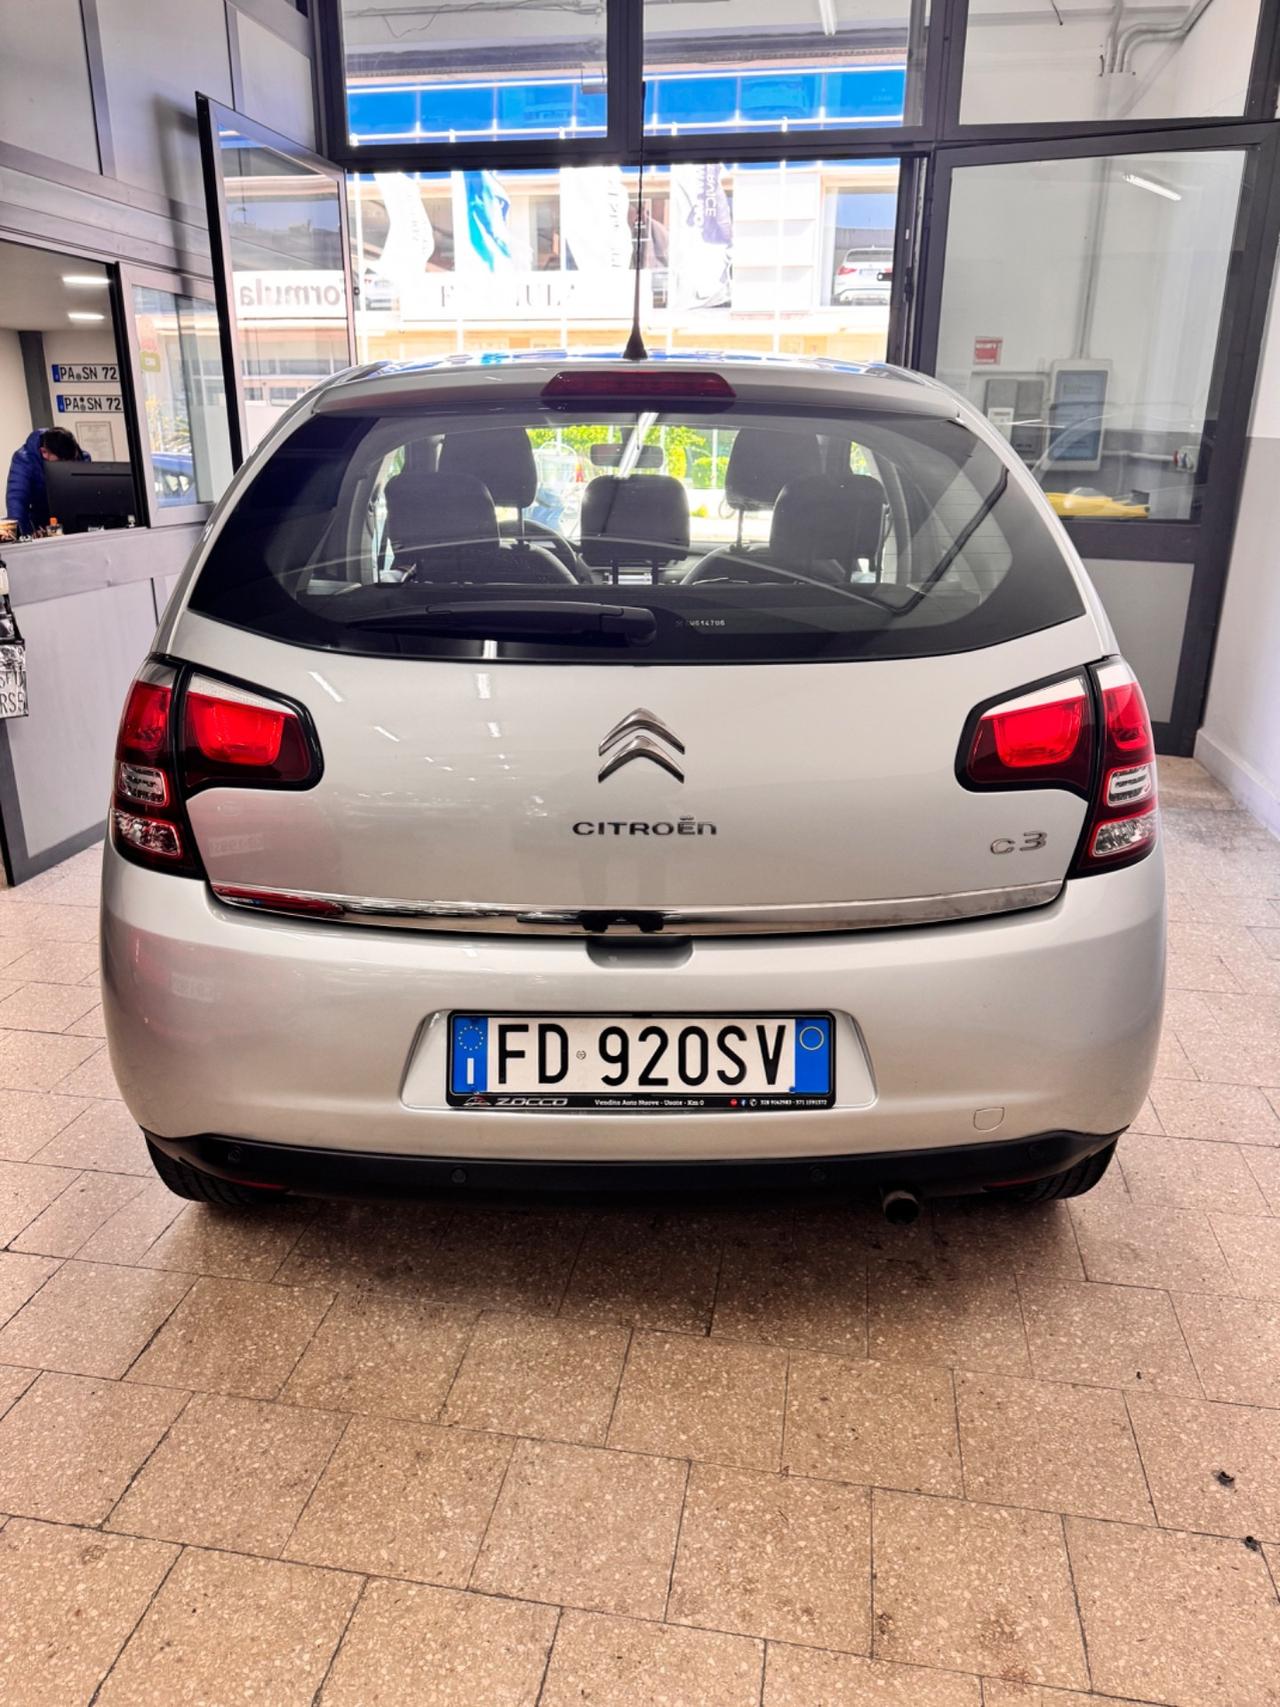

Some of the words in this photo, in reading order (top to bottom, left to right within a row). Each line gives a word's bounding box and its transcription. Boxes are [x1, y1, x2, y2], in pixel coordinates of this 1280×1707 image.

[60, 366, 75, 380] PA
[82, 366, 98, 380] SN
[102, 366, 118, 380] 72
[65, 397, 80, 410] PA
[87, 397, 103, 411] SN
[106, 397, 122, 411] 72
[989, 830, 1048, 855] C3
[497, 1023, 569, 1085] FD
[598, 1024, 787, 1087] 920SV
[466, 1058, 475, 1085] I
[494, 1097, 569, 1107] ZOCCO
